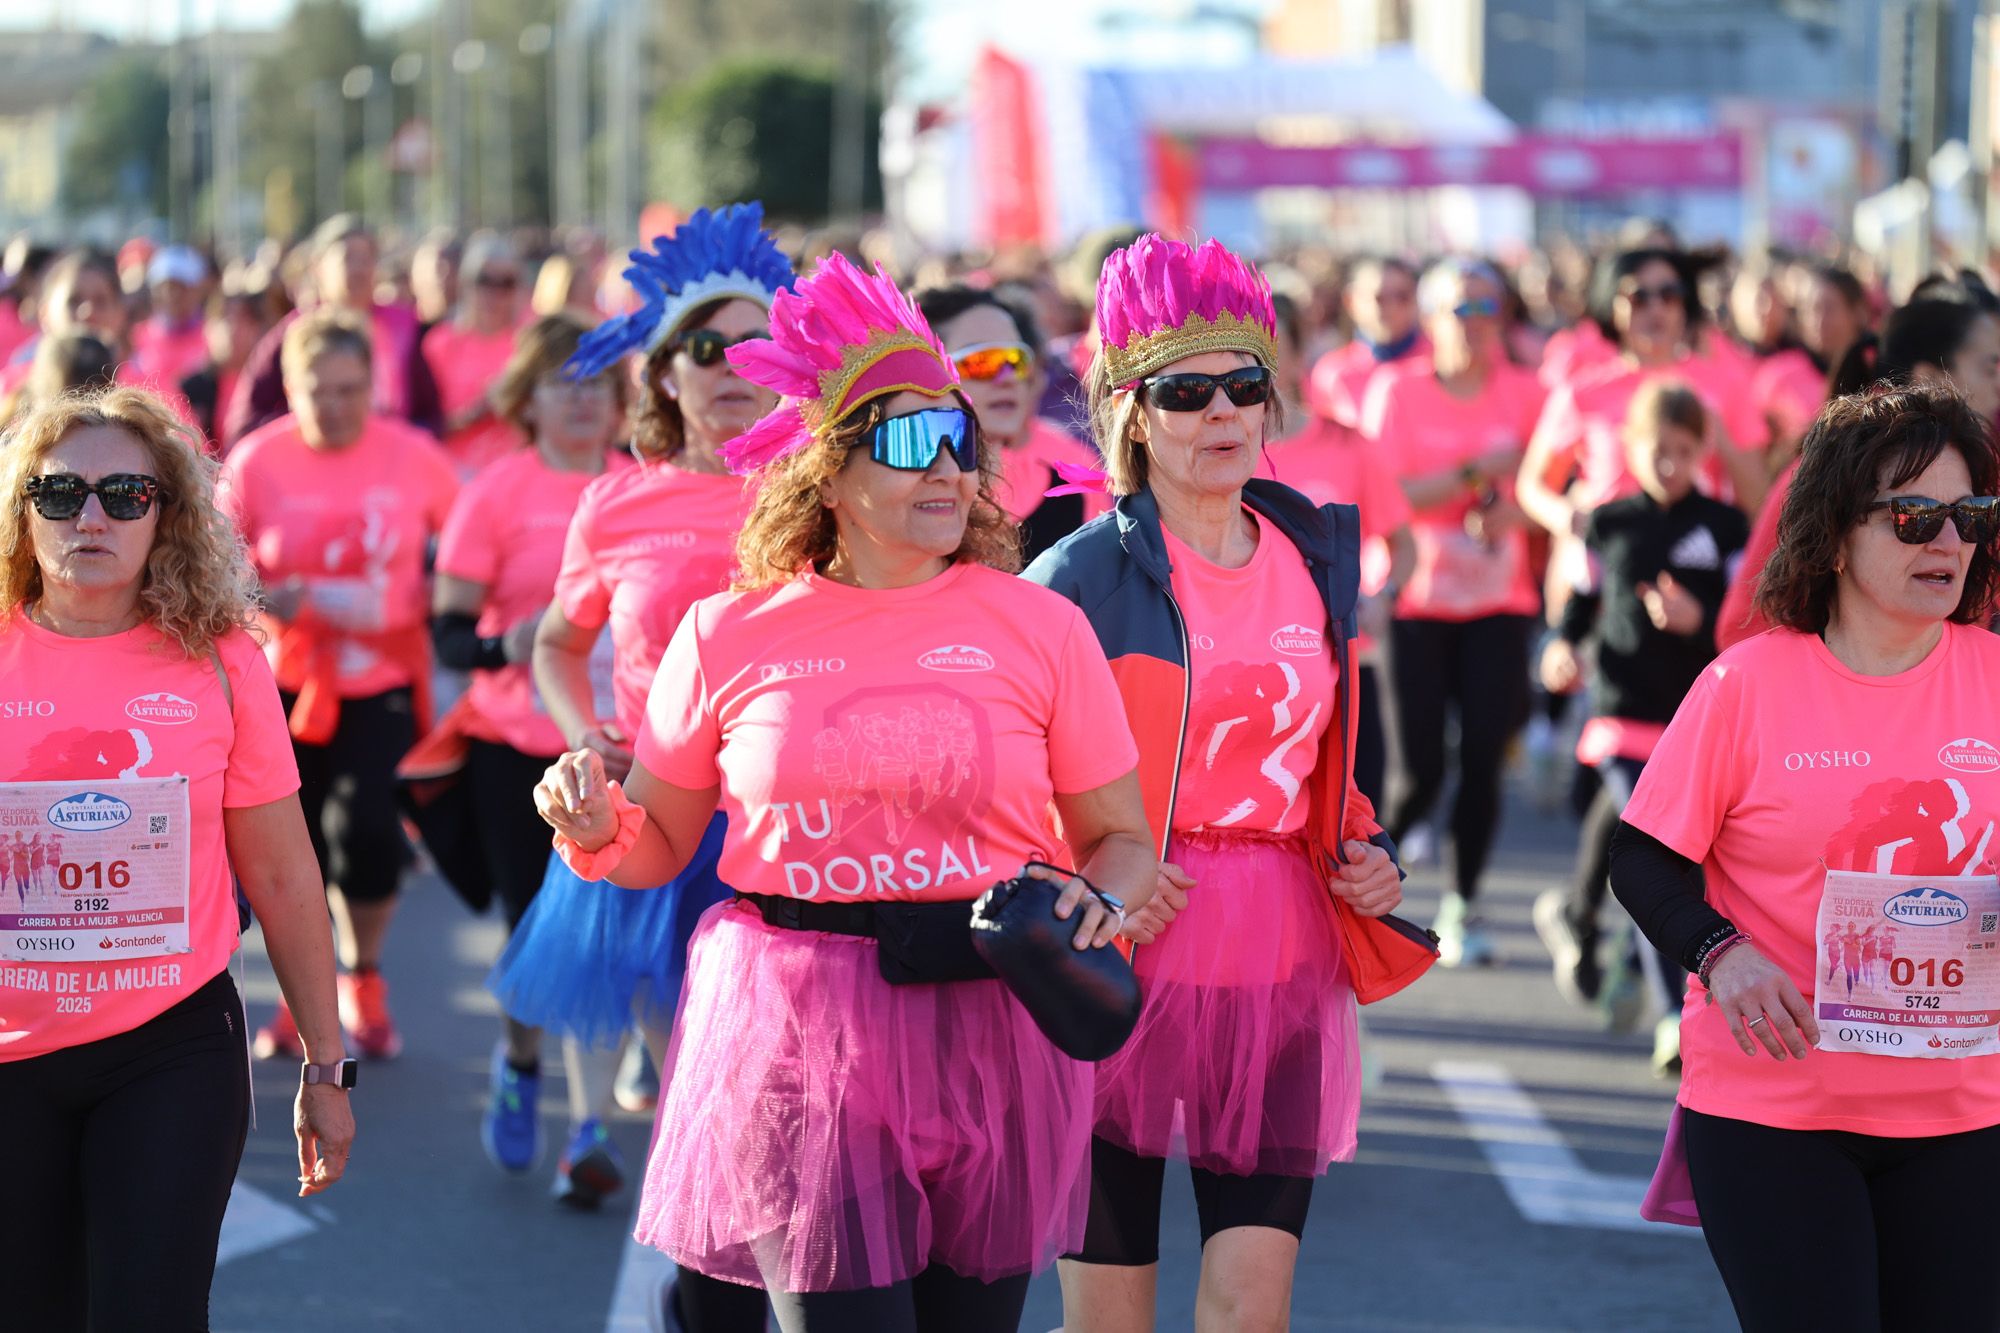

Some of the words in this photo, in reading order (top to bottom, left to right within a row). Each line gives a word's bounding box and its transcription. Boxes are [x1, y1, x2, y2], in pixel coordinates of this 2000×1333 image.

[924, 656, 989, 669] ASTURIANA
[132, 703, 193, 718] ASTURIANA
[1784, 750, 1871, 771] OYSHO
[1944, 750, 1999, 765] ASTURIANA
[2, 815, 40, 826] SUMA
[53, 807, 126, 822] ASTURIANA
[769, 798, 833, 843] TU
[58, 860, 130, 890] 016
[784, 836, 991, 900] DORSAL
[74, 898, 109, 911] 8192
[1834, 905, 1875, 917] SUMA
[1889, 901, 1962, 917] ASTURIANA
[18, 917, 57, 927] CARRERA
[59, 917, 71, 926] DE
[74, 916, 86, 926] LA
[88, 915, 118, 925] MUJER
[126, 912, 164, 924] VALENCIA
[16, 937, 75, 951] OYSHO
[115, 935, 166, 948] Santander
[0, 967, 49, 992] RERA
[55, 972, 79, 993] DE
[86, 972, 108, 992] LA
[114, 963, 181, 991] MUJER
[1890, 957, 1964, 987] 016
[56, 997, 92, 1013] 2025
[1905, 995, 1940, 1009] 5742
[1843, 1008, 1885, 1021] CARRERA
[1888, 1014, 1900, 1022] DE
[1903, 1014, 1915, 1023] LA
[1918, 1015, 1947, 1024] MUJER
[1955, 1014, 1989, 1025] VALENCIA
[1839, 1028, 1903, 1046] OYSHO
[1943, 1036, 1985, 1049] Santander
